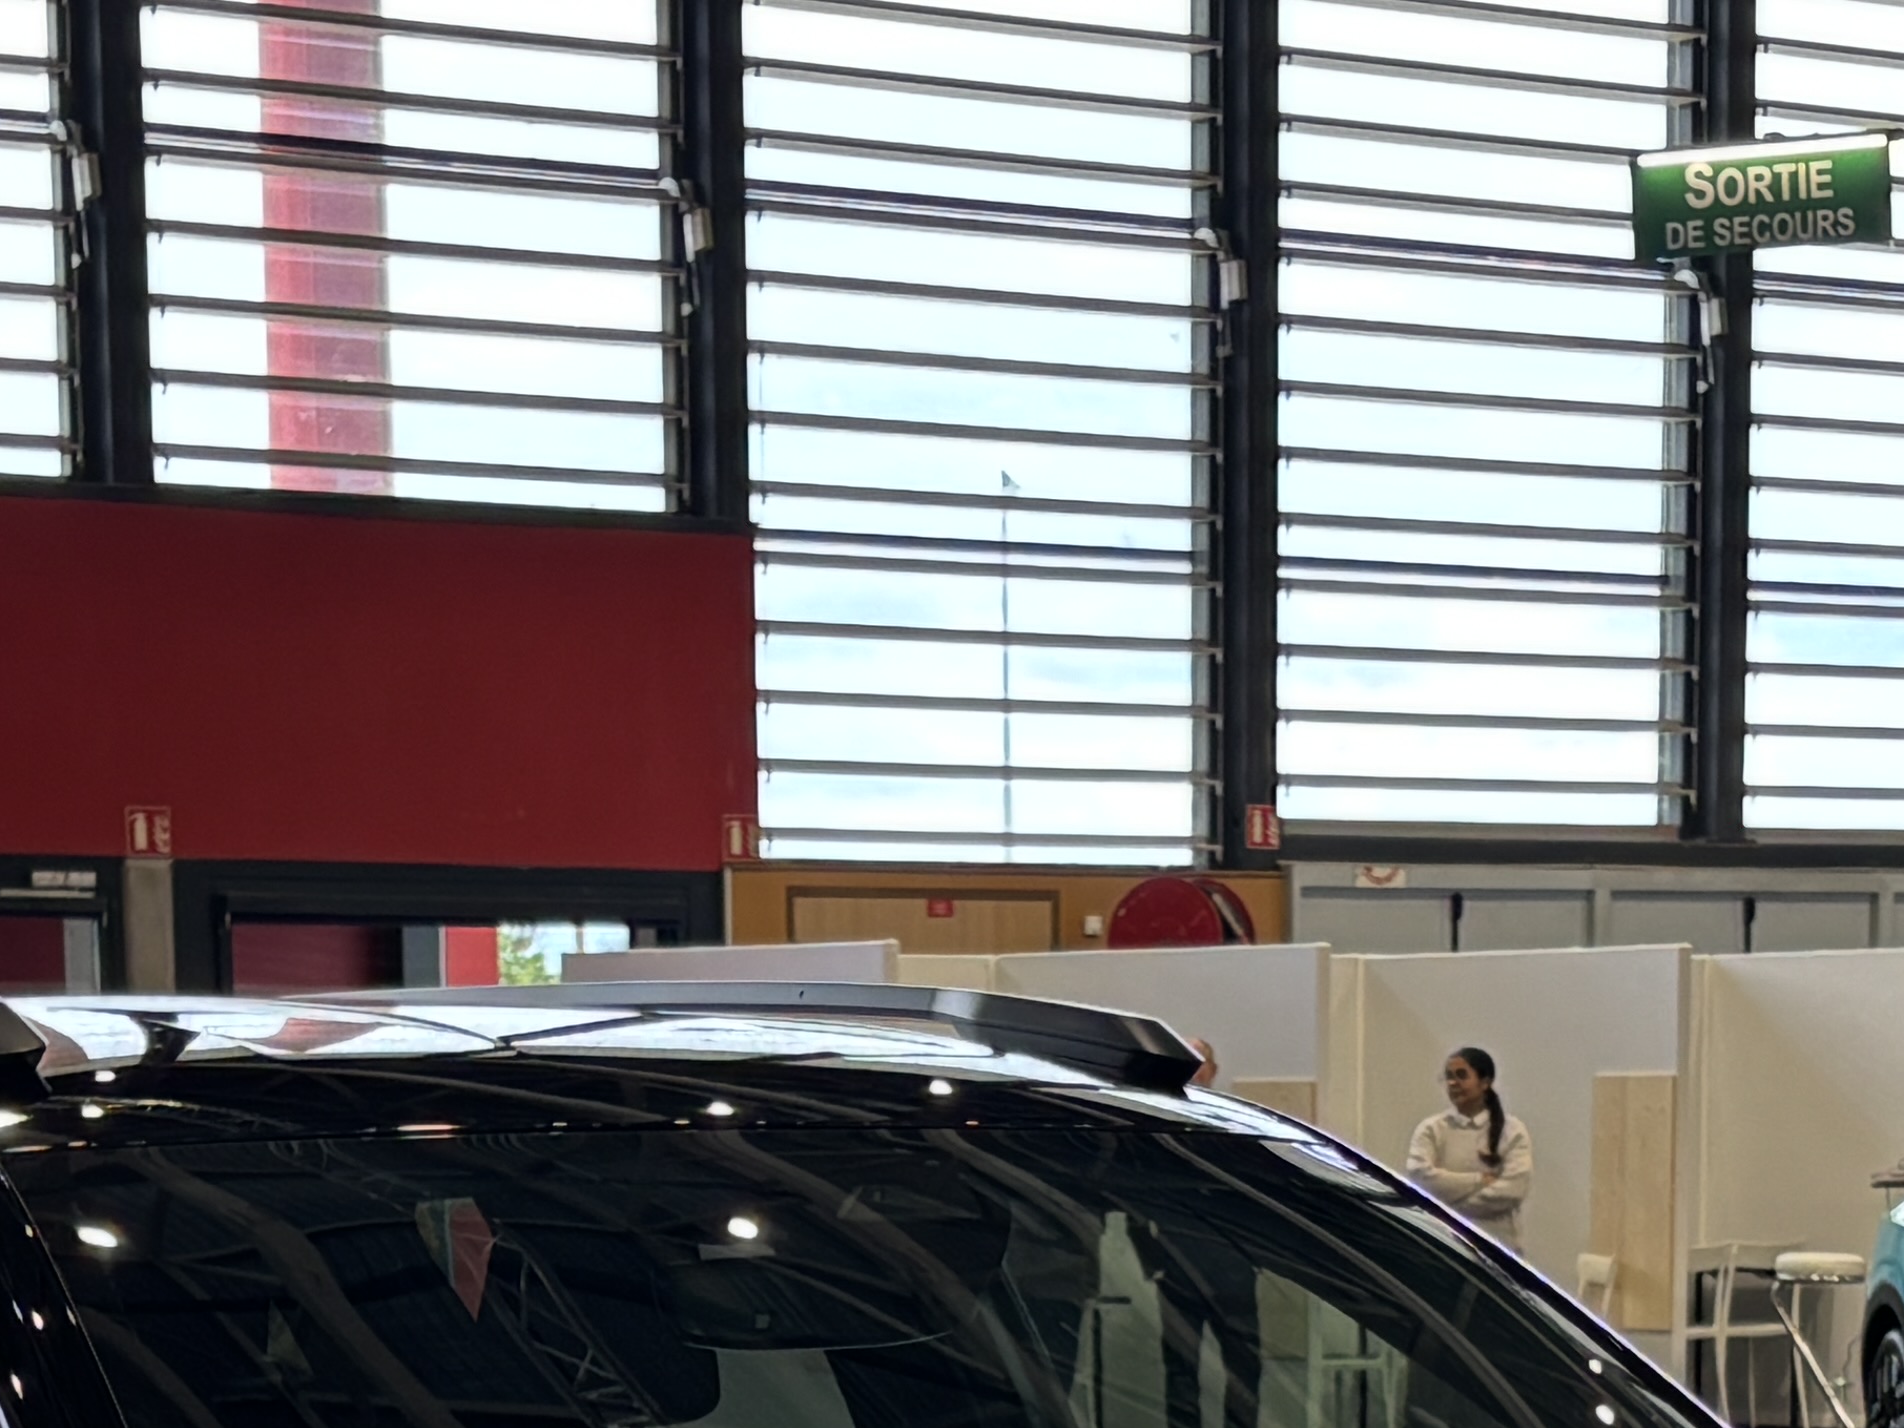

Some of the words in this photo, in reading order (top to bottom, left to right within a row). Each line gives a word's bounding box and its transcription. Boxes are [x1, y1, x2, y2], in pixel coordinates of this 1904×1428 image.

[1683, 159, 1835, 209] SORTIE
[1665, 220, 1707, 250] DE
[1712, 206, 1857, 247] SECOURS
